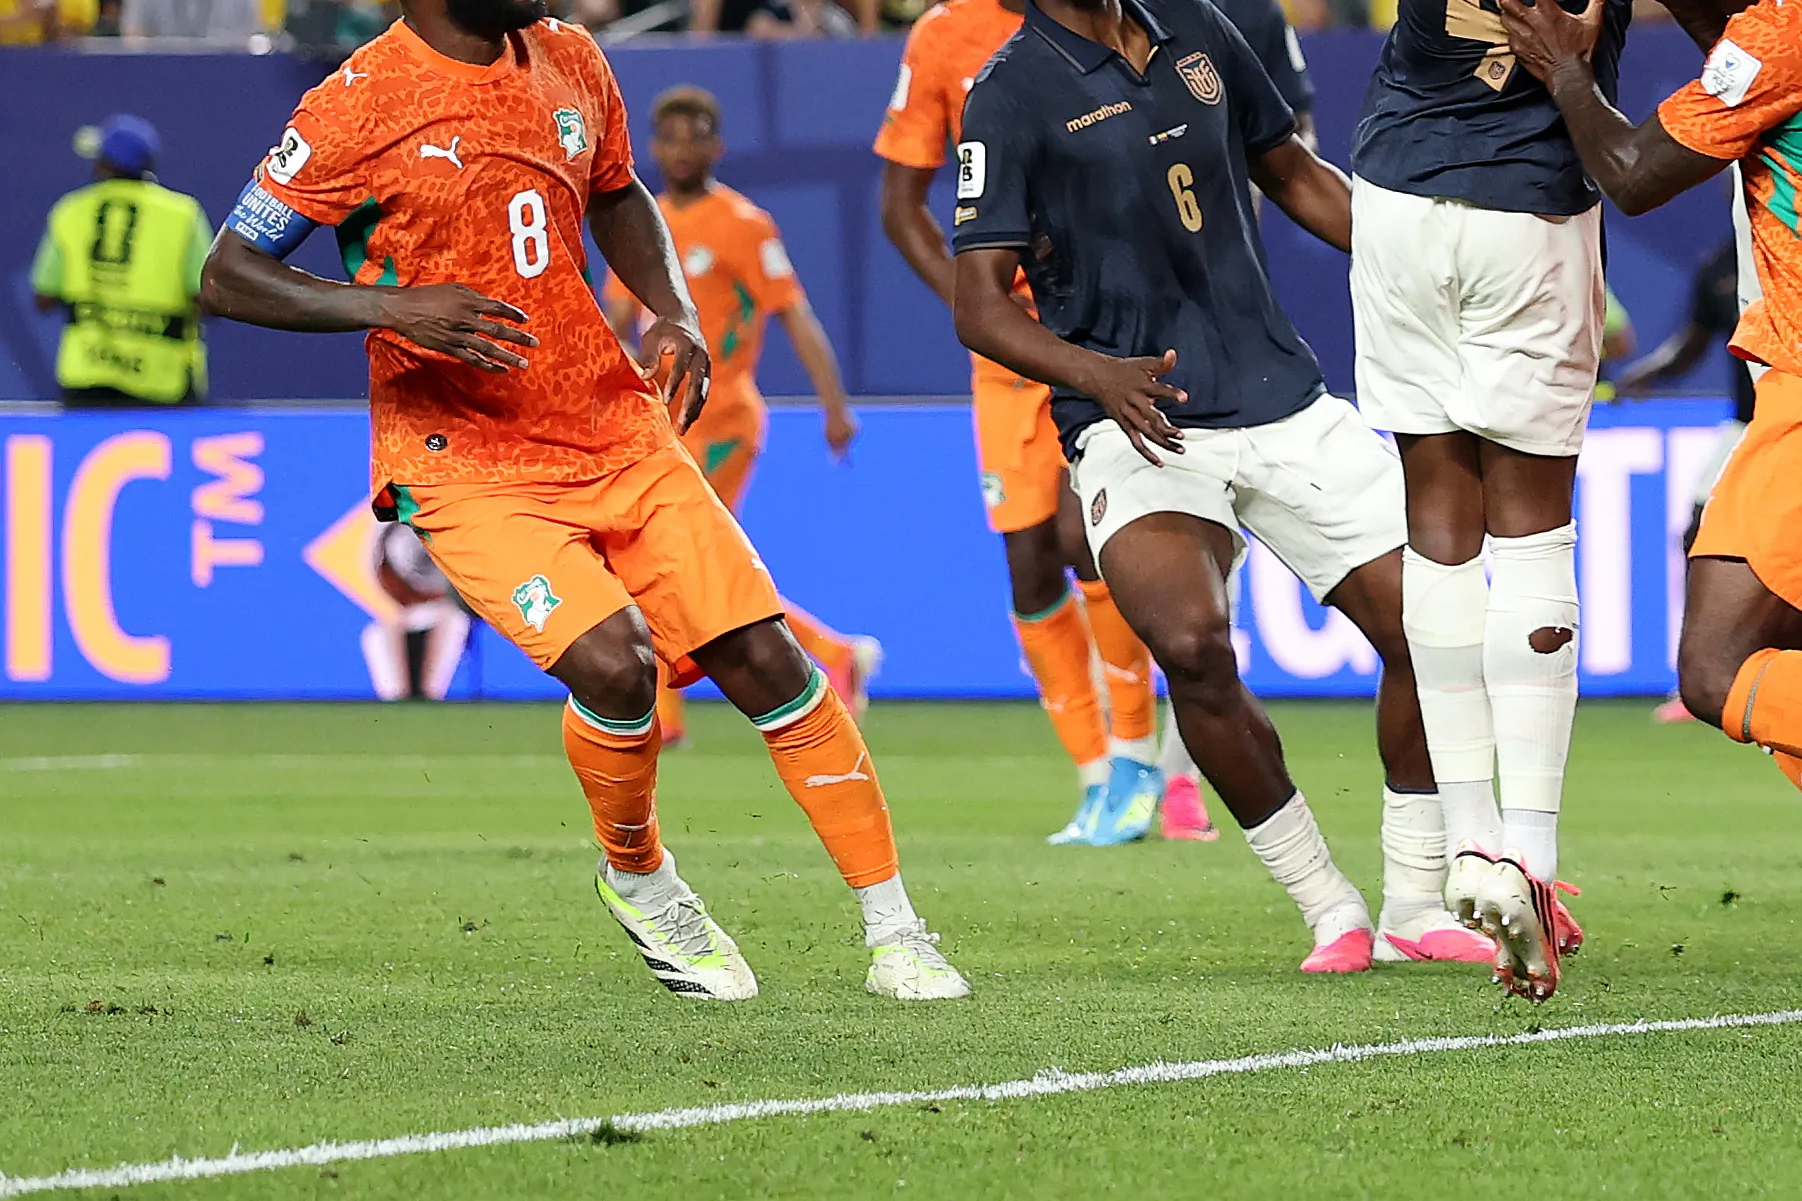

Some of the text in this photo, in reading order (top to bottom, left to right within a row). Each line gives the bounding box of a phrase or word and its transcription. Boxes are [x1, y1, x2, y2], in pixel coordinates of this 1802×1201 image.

[1066, 101, 1132, 133] marathon
[242, 192, 289, 231] UNITES
[250, 184, 294, 220] FOOTBALL
[1167, 163, 1203, 233] 6
[245, 213, 284, 242] World
[508, 189, 549, 279] 8
[191, 431, 265, 588] TM
[5, 430, 173, 686] IC
